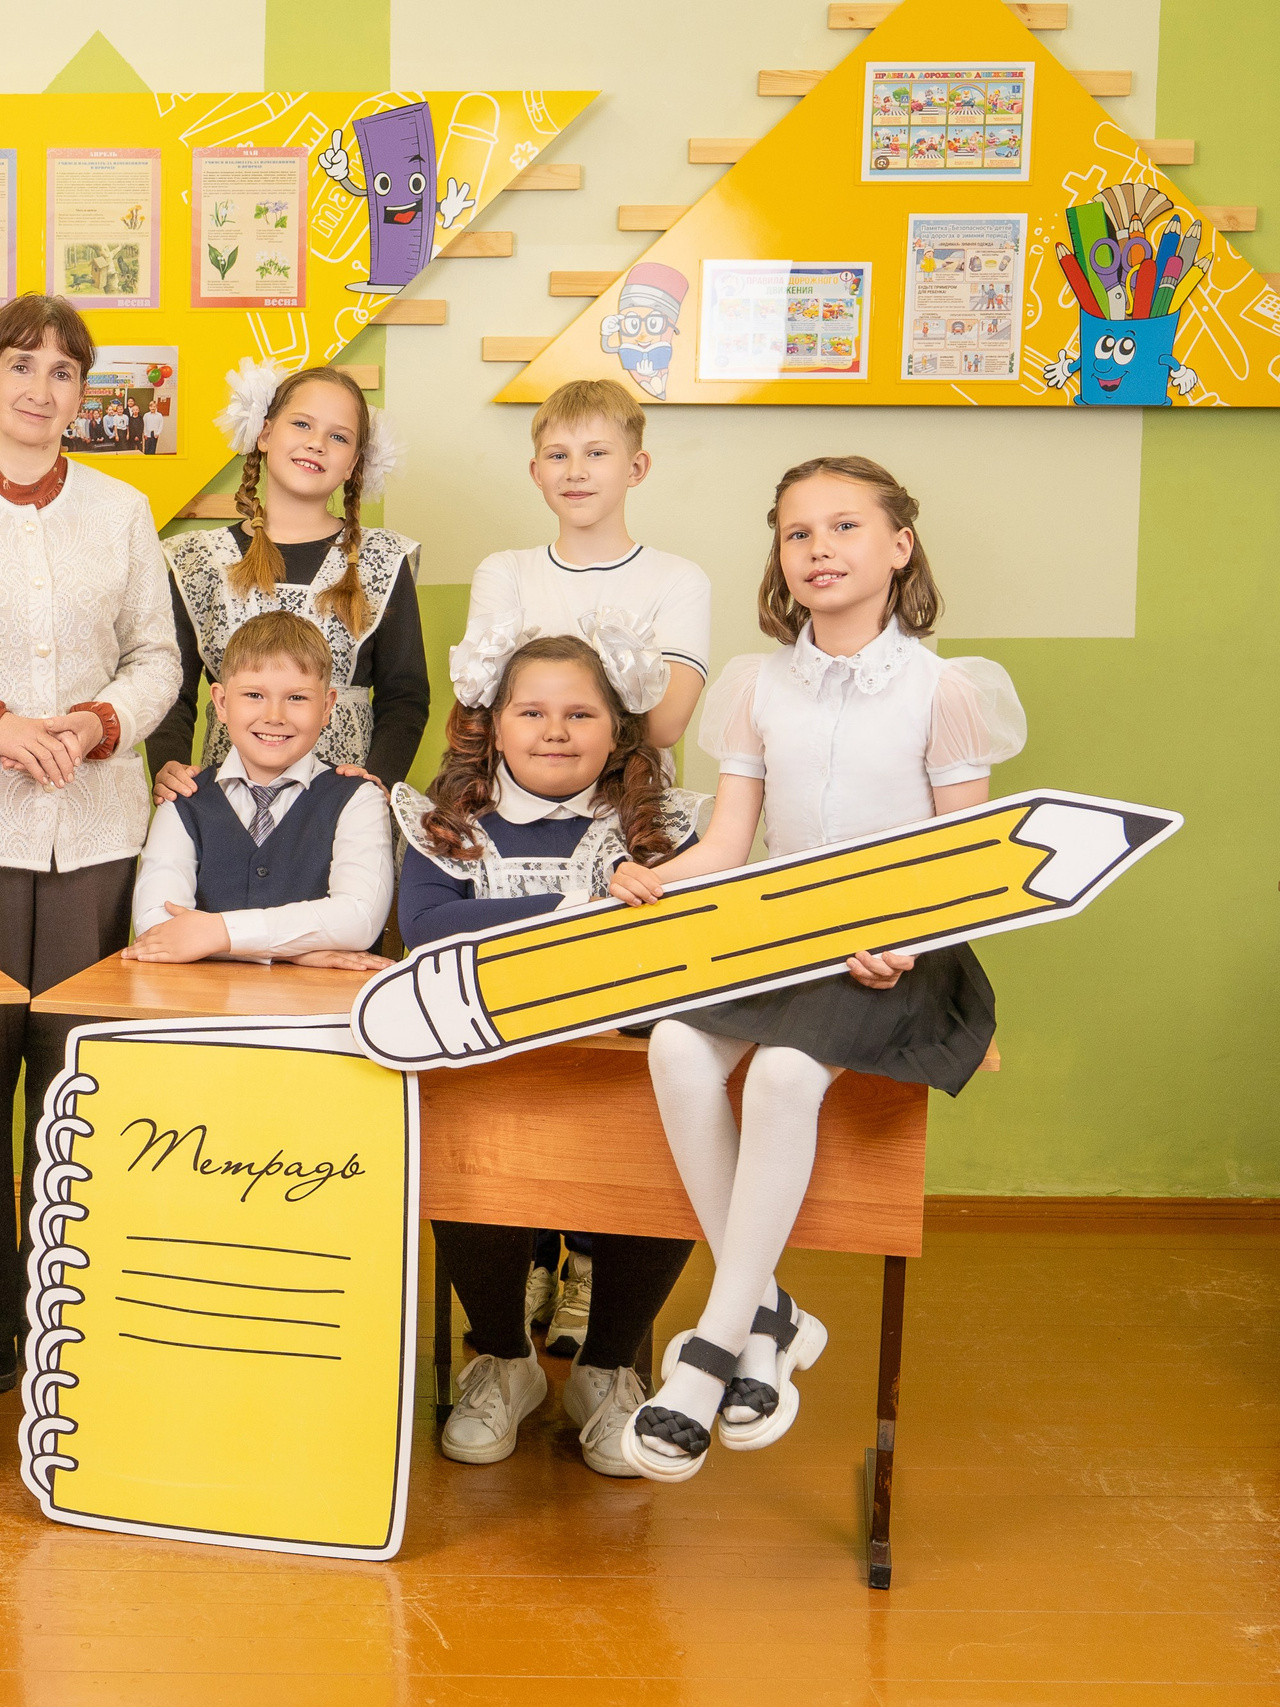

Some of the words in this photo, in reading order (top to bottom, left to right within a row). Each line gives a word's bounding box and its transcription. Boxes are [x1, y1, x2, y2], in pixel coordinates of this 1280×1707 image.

[974, 71, 1024, 79] ДВИЖЕНИЯ
[788, 276, 839, 285] ДОРОЖНОГО
[765, 286, 814, 295] ДВИЖЕНИЯ
[117, 299, 151, 307] весна
[264, 298, 298, 306] весна
[120, 1117, 366, 1203] Тетрадь
